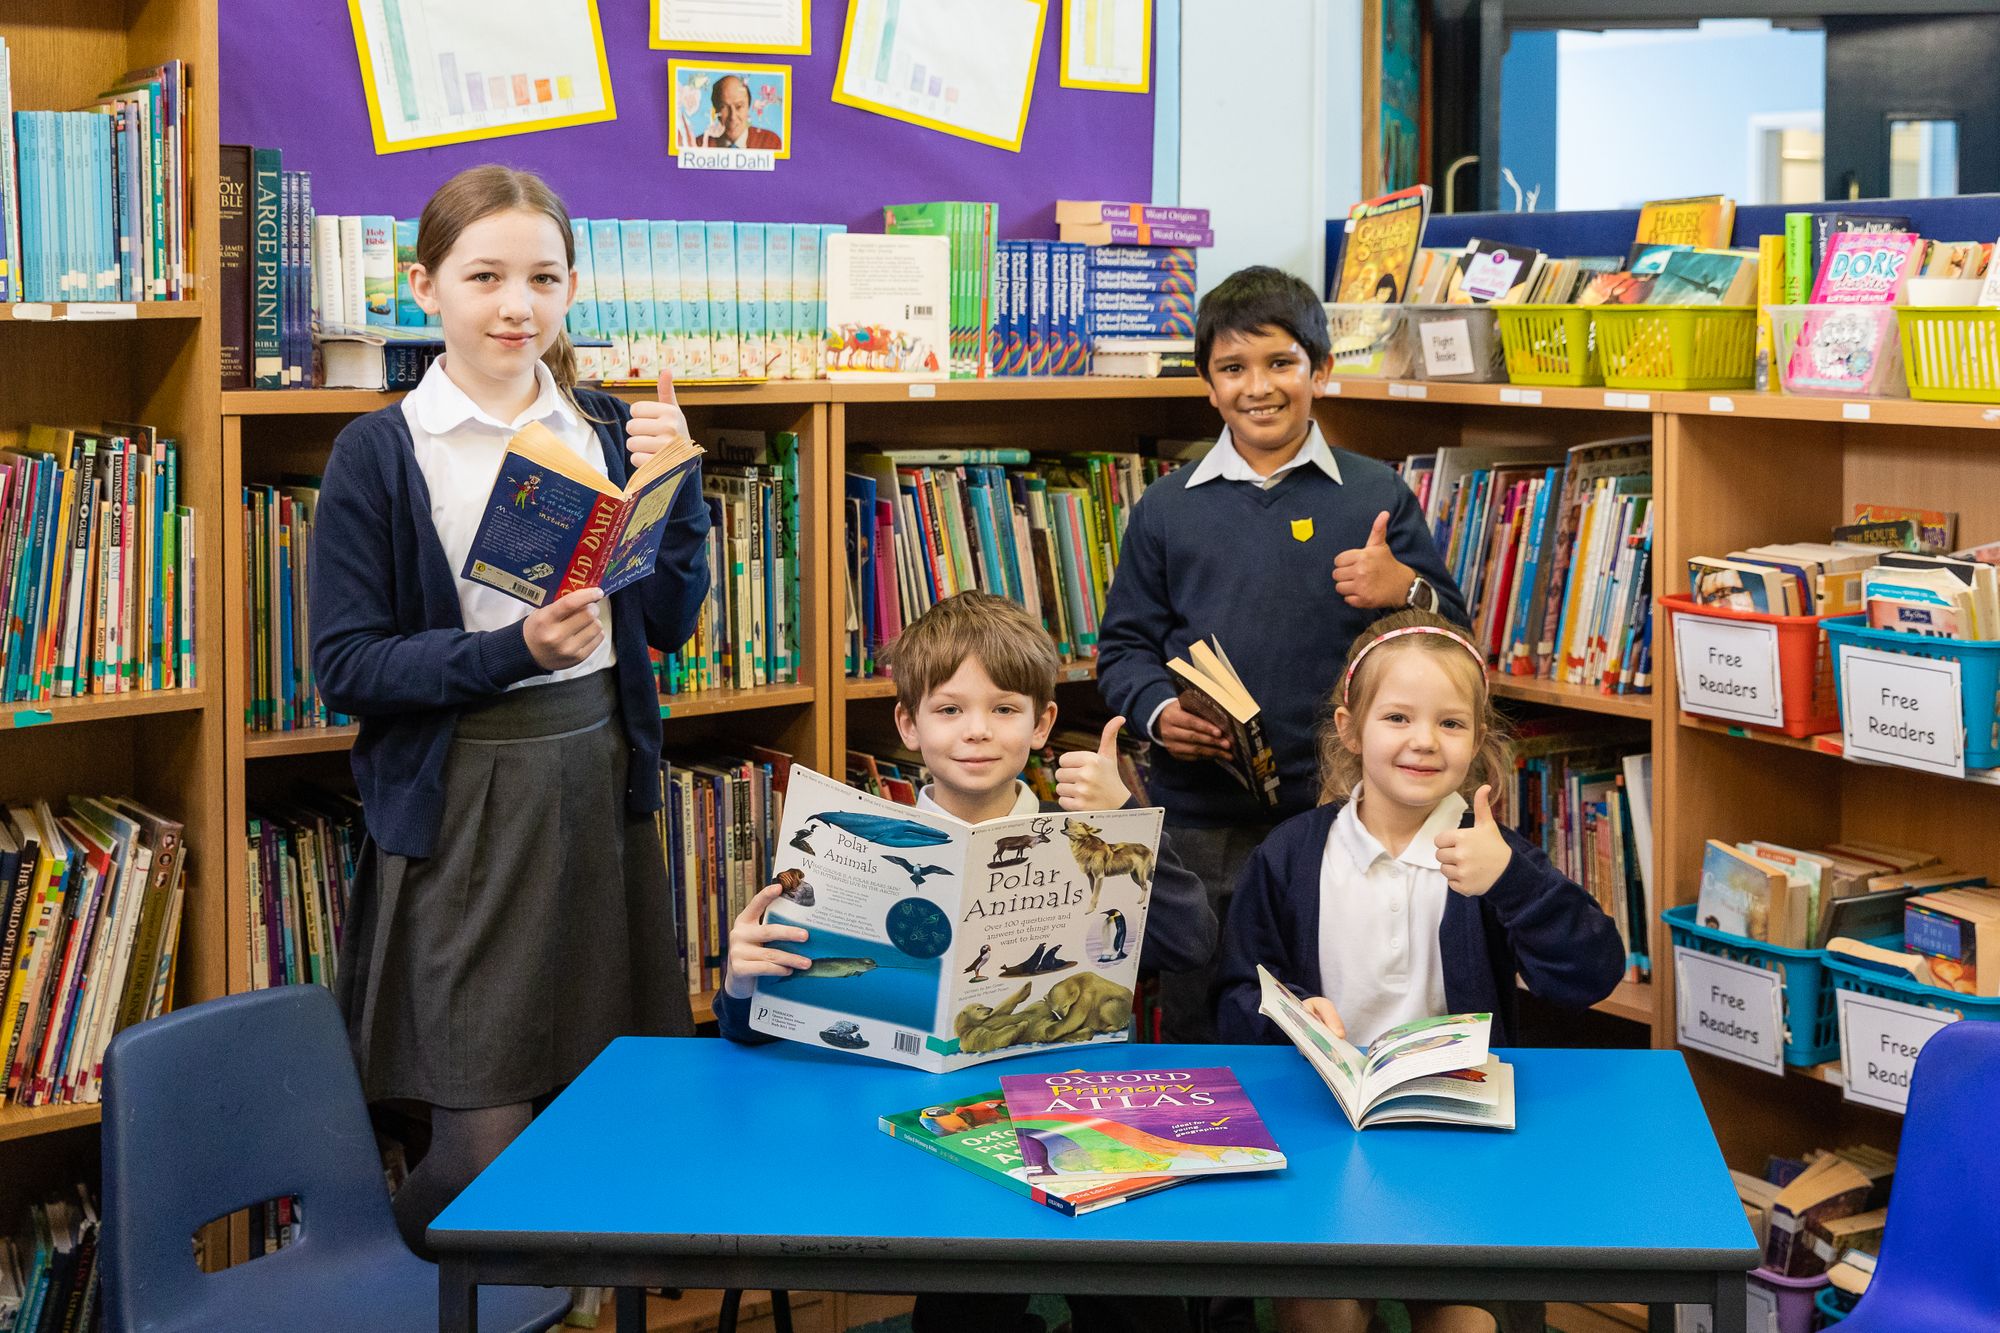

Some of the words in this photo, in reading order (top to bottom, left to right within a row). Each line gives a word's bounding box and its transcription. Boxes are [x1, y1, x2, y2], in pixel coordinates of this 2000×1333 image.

[683, 151, 730, 168] Roald
[735, 152, 770, 170] Dahl
[219, 182, 243, 196] OLY
[257, 171, 277, 254] LARGE
[1103, 208, 1129, 218] Oxford
[1145, 209, 1167, 220] Word
[1168, 211, 1197, 224] Origins
[1655, 211, 1704, 230] HARRY
[365, 238, 387, 246] Bible
[366, 229, 385, 240] Holy
[1112, 228, 1138, 238] Oxford
[1152, 230, 1173, 240] Word
[1174, 231, 1202, 244] Origins
[1096, 247, 1121, 256] Oxford
[1121, 247, 1148, 258] Popular
[1096, 271, 1121, 280] Oxford
[1121, 271, 1148, 282] Popular
[1830, 252, 1903, 279] DORK
[258, 261, 277, 336] PRINT
[1000, 282, 1009, 314] Popular
[1018, 282, 1027, 314] Popular
[1039, 282, 1048, 314] Popular
[1059, 283, 1068, 315] Popular
[1076, 283, 1085, 315] Popular
[1095, 293, 1120, 302] Oxford
[1120, 293, 1147, 303] Popular
[1096, 314, 1121, 323] Oxford
[1121, 314, 1148, 324] Popular
[398, 349, 406, 382] Oxford
[82, 458, 94, 503] EYEWITNESS
[113, 456, 122, 502] EYEWITNESS
[35, 515, 45, 547] COBRAS
[77, 520, 88, 547] GUIDES
[102, 512, 110, 550] Discovering
[112, 518, 122, 546] GUIDES
[580, 500, 619, 553] DAHL
[1708, 647, 1742, 668] Free
[1698, 674, 1757, 699] Readers
[1881, 688, 1920, 712] Free
[1868, 716, 1935, 746] Readers
[838, 833, 869, 854] Polar
[18, 860, 34, 884] THE
[824, 849, 878, 874] Animals
[986, 863, 1060, 893] Polar
[8, 881, 31, 925] WORLD
[963, 880, 1083, 922] Animals
[5, 926, 20, 946] OF
[984, 923, 1002, 932] Over
[1004, 920, 1020, 928] 100
[1020, 916, 1056, 926] questions
[986, 930, 1014, 940] answers
[1026, 924, 1050, 934] things
[1051, 922, 1066, 931] you
[1000, 937, 1018, 946] want
[1029, 933, 1052, 941] know
[1, 944, 17, 971] THE
[133, 953, 152, 990] TUDOR
[1710, 985, 1746, 1012] Free
[1700, 1010, 1760, 1045] Readers
[1880, 1033, 1918, 1060] Free
[1044, 1072, 1192, 1087] OXFORD
[1867, 1062, 1909, 1088] Read
[1050, 1082, 1195, 1098] Primary
[1042, 1092, 1216, 1114] ATLAS
[1171, 1122, 1190, 1131] Ideal
[1191, 1120, 1204, 1128] for
[1172, 1126, 1200, 1136] young
[1174, 1126, 1229, 1138] geographers
[961, 1130, 1016, 1148] Oxfo
